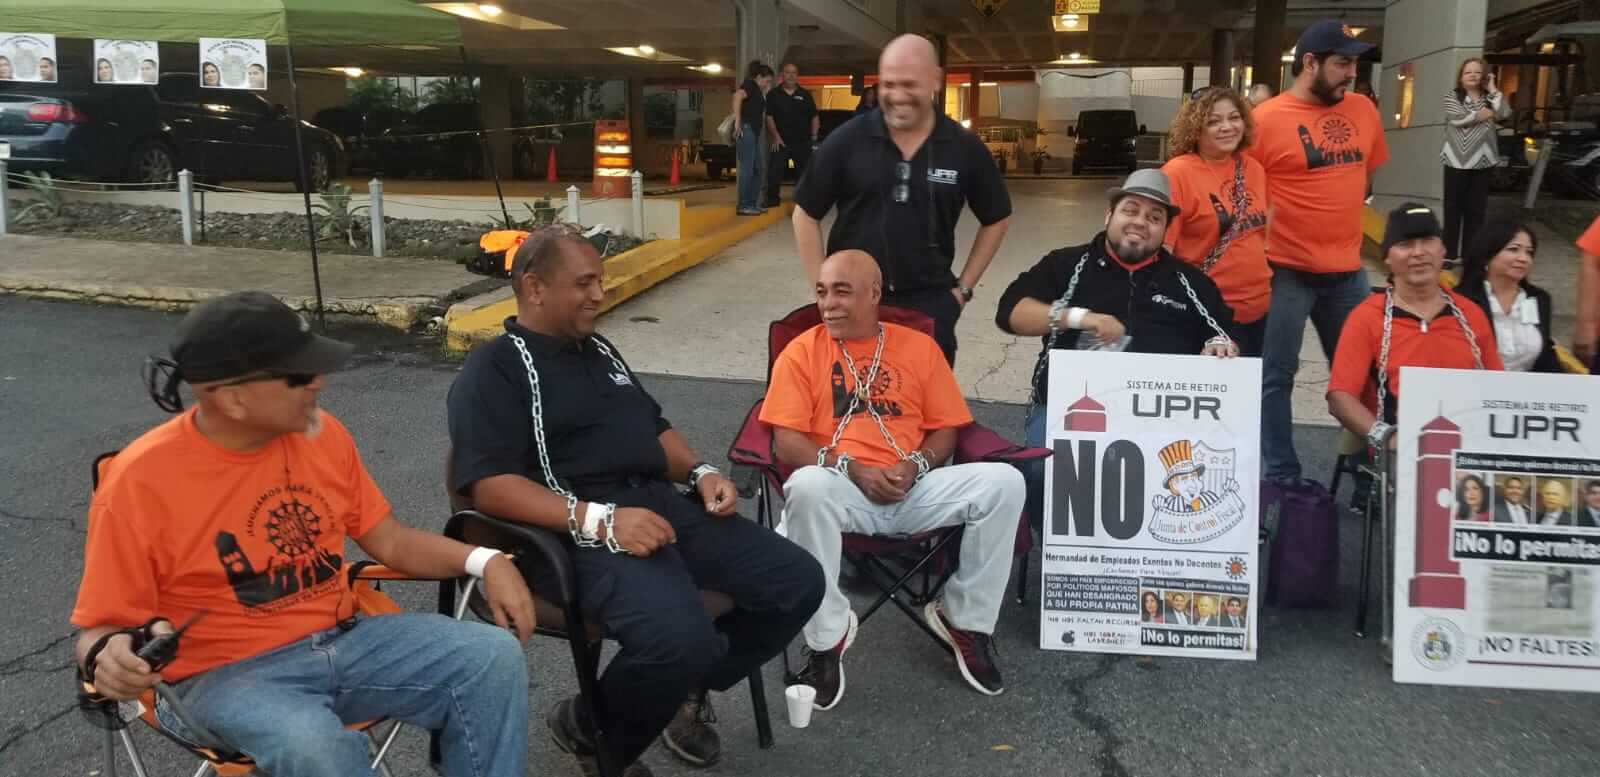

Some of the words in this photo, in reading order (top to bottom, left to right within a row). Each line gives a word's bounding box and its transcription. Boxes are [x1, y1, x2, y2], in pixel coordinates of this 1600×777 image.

[1127, 380, 1172, 390] SISTEMA
[1174, 382, 1187, 391] DE
[1190, 383, 1228, 393] RETIRO
[1132, 393, 1221, 420] UPR
[1489, 413, 1580, 442] UPR
[1051, 439, 1145, 541] NO
[1455, 531, 1491, 554] ¡No
[1495, 533, 1516, 555] lo
[1045, 552, 1088, 562] Hermandad
[1105, 602, 1138, 611] PATRIA
[1142, 629, 1164, 643] ¡No
[1168, 630, 1180, 644] lo
[1183, 633, 1244, 648] permitas!
[1479, 635, 1512, 654] ¡NO
